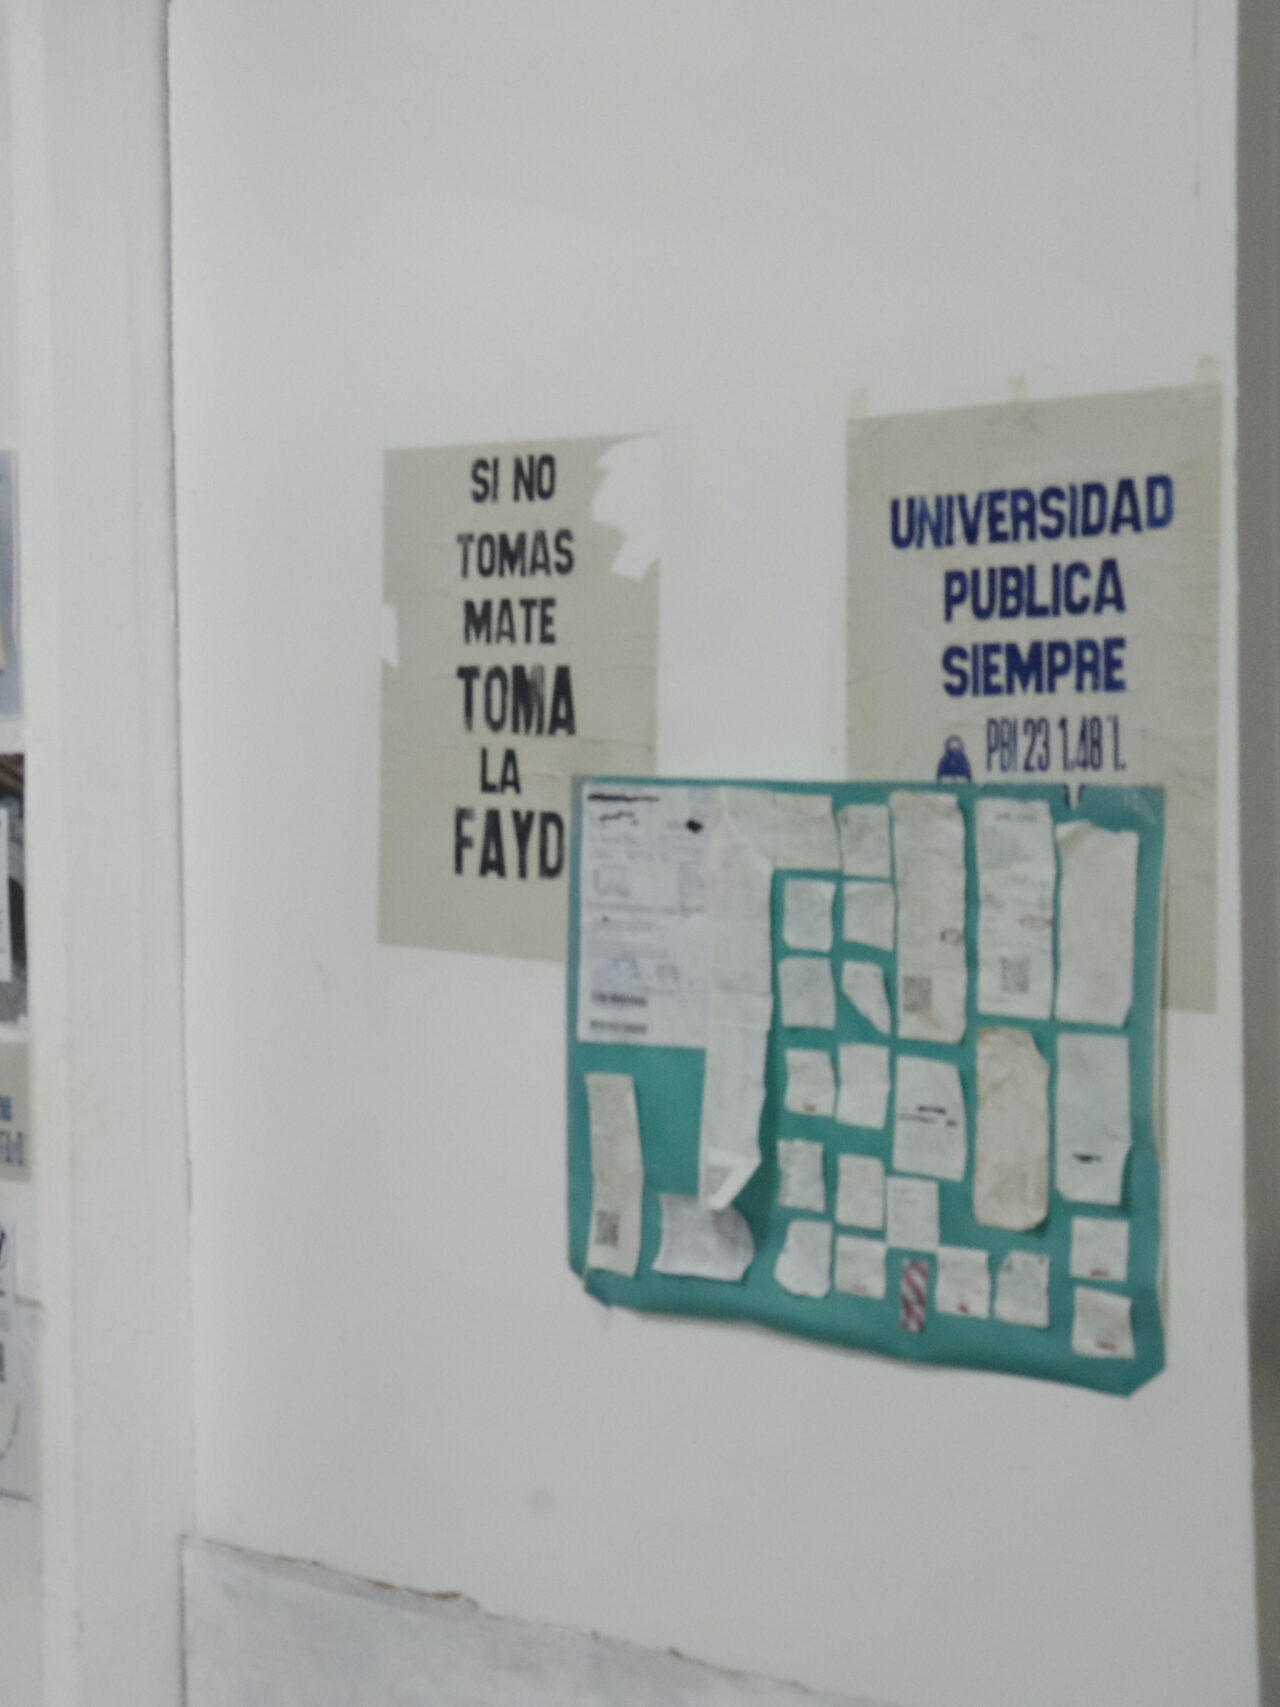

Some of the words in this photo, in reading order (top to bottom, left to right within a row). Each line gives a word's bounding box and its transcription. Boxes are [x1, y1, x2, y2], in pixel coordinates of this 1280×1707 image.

[471, 456, 499, 504] SI
[513, 454, 556, 502] NO
[890, 474, 1174, 550] UNIVERSIDAD
[457, 528, 575, 579] TOMAS
[944, 558, 1126, 623] PUBLICA
[464, 597, 556, 645] MATE
[942, 636, 1126, 698] SIEMPRE
[456, 664, 576, 737] TOMA
[480, 747, 521, 795] LA
[986, 717, 1018, 773] PBI
[1022, 716, 1051, 773] 23
[454, 807, 565, 880] FAYD
